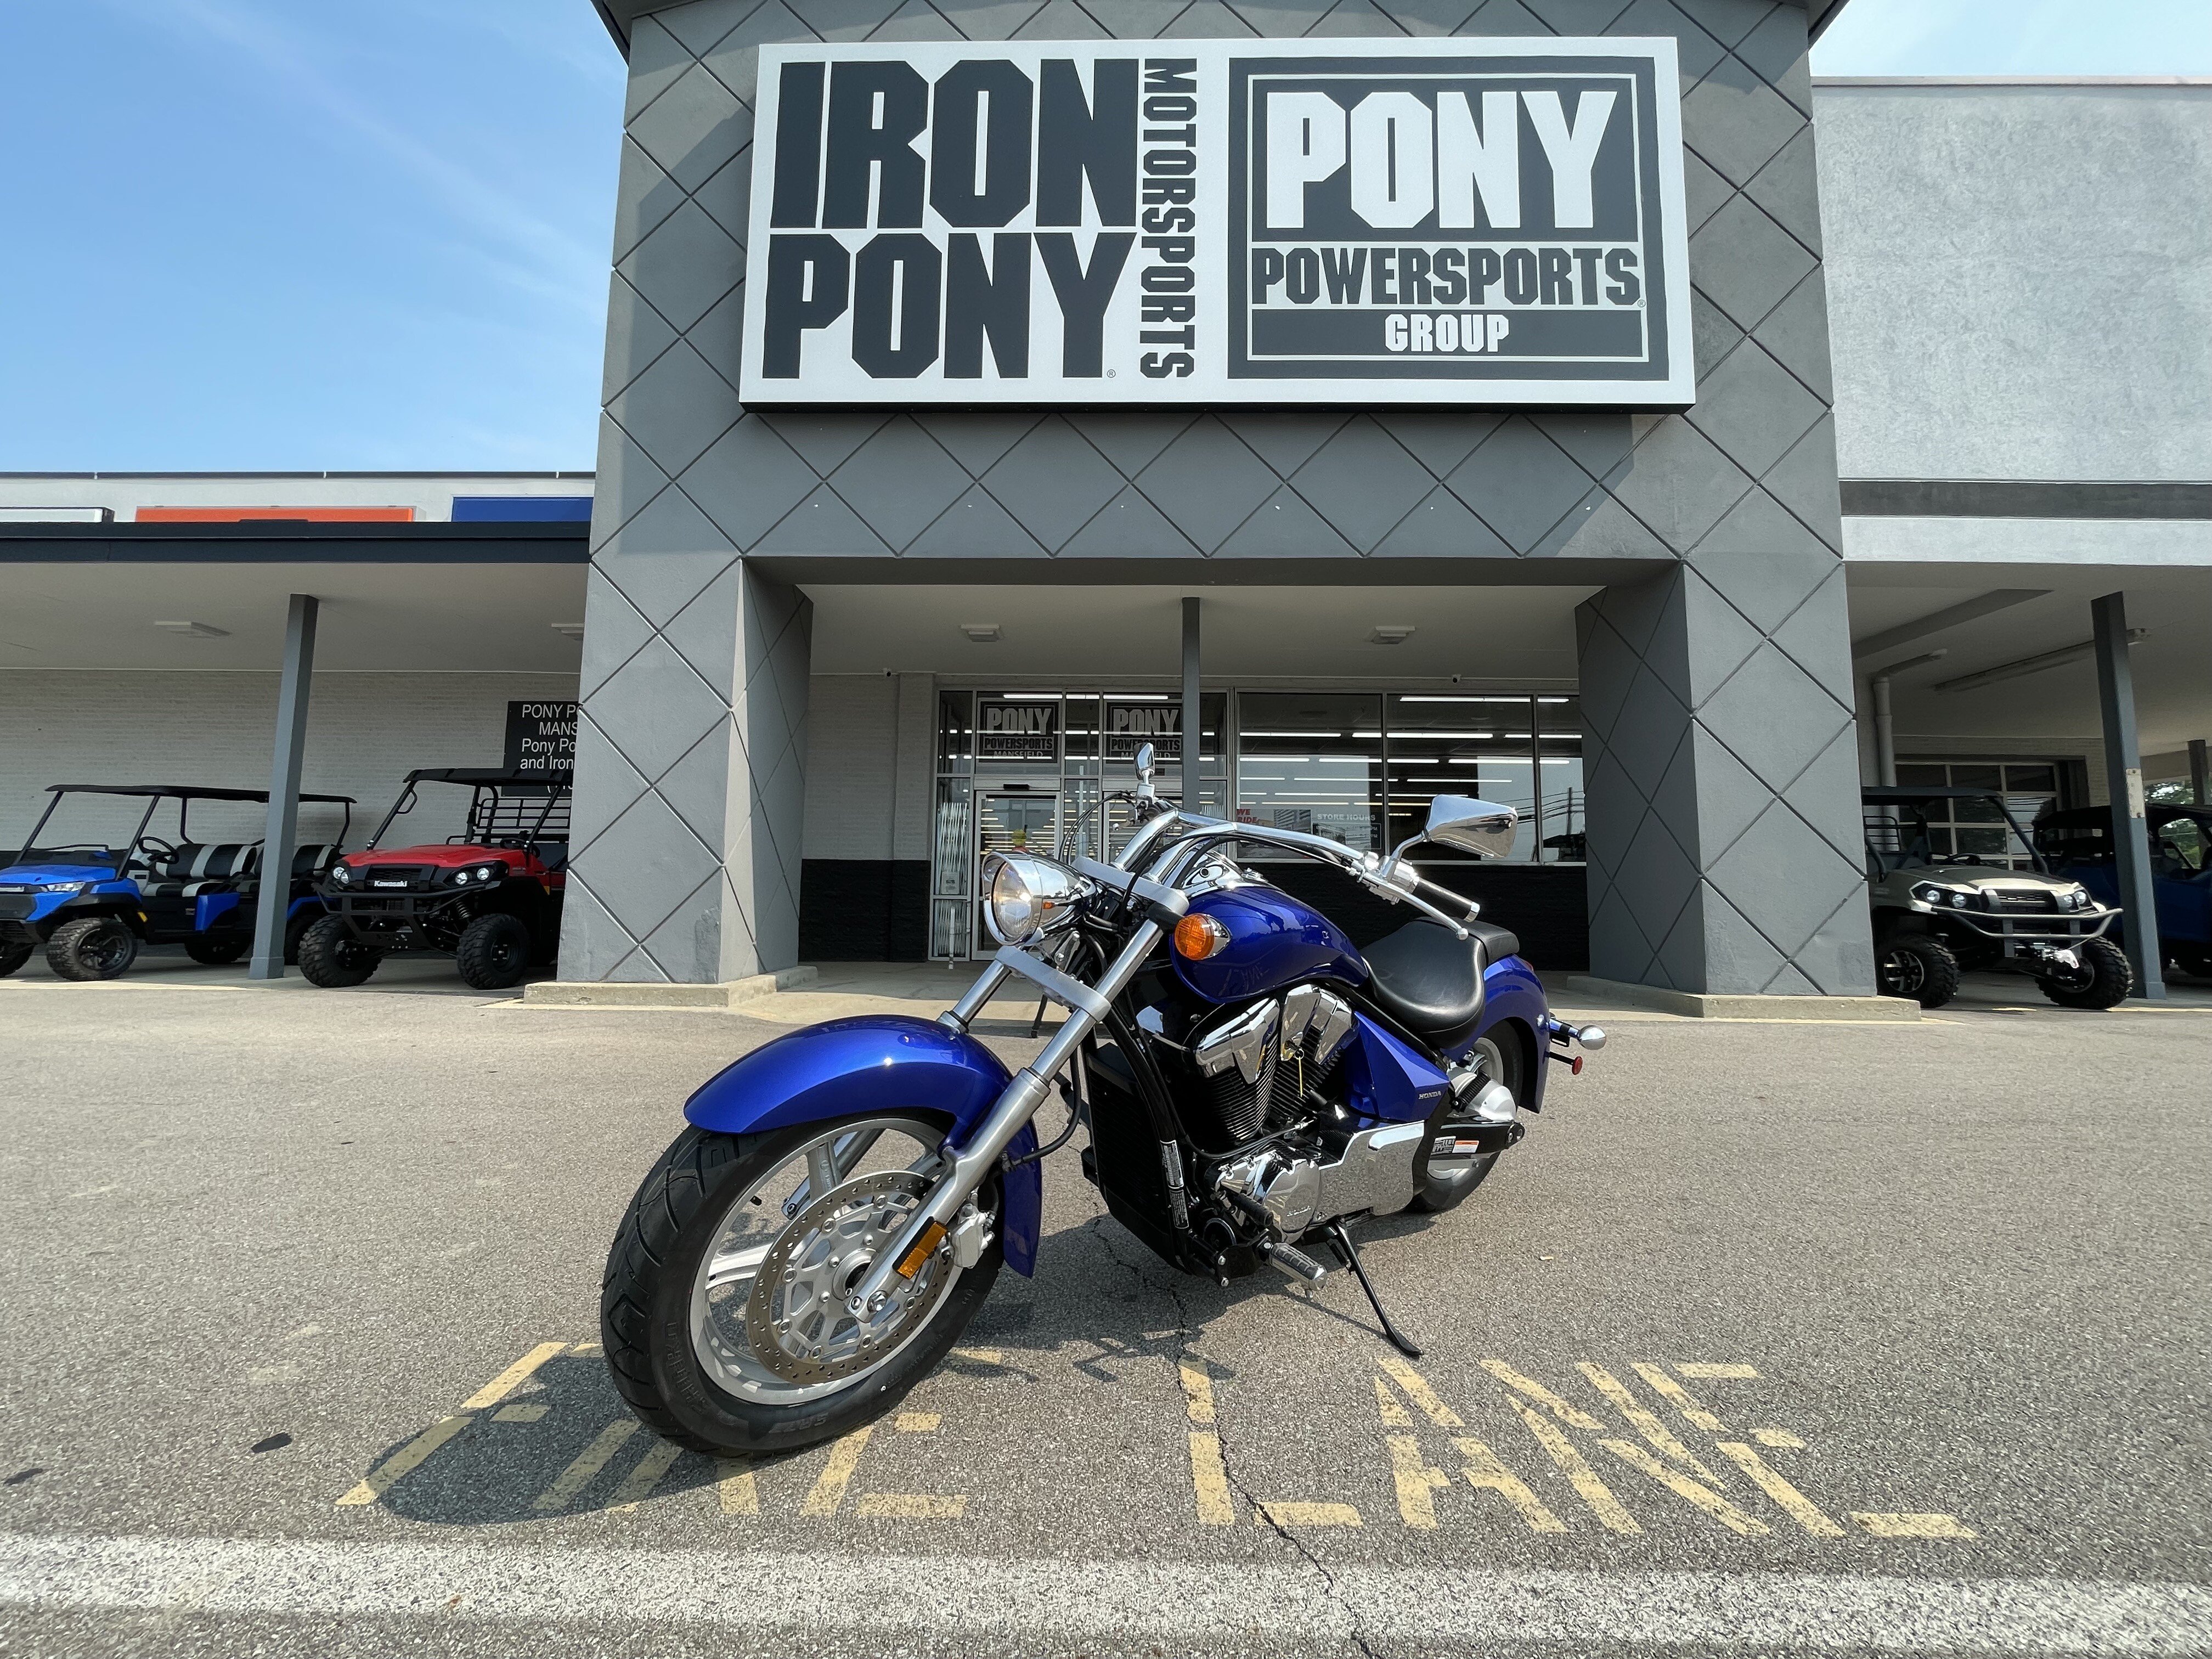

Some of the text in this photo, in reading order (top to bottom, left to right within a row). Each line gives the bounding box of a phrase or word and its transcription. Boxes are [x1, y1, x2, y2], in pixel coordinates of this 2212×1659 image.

[770, 59, 1139, 229] IRON
[1266, 91, 1617, 228] PONY
[1140, 58, 1198, 379] MOTORSPORTS
[1251, 247, 1640, 305] POWERSPORTS
[762, 232, 1137, 379] PONY
[1385, 314, 1510, 352] GROUP
[522, 704, 563, 718] PONY
[987, 708, 1052, 735] PONY
[1113, 709, 1178, 736] PONY
[539, 721, 578, 735] MANS
[521, 738, 577, 755] Pony Po
[984, 738, 1053, 749] POWERSPORTS
[520, 755, 574, 769] and Iron
[1418, 1091, 1442, 1099] HONDA
[1180, 1358, 1977, 1538] LANE
